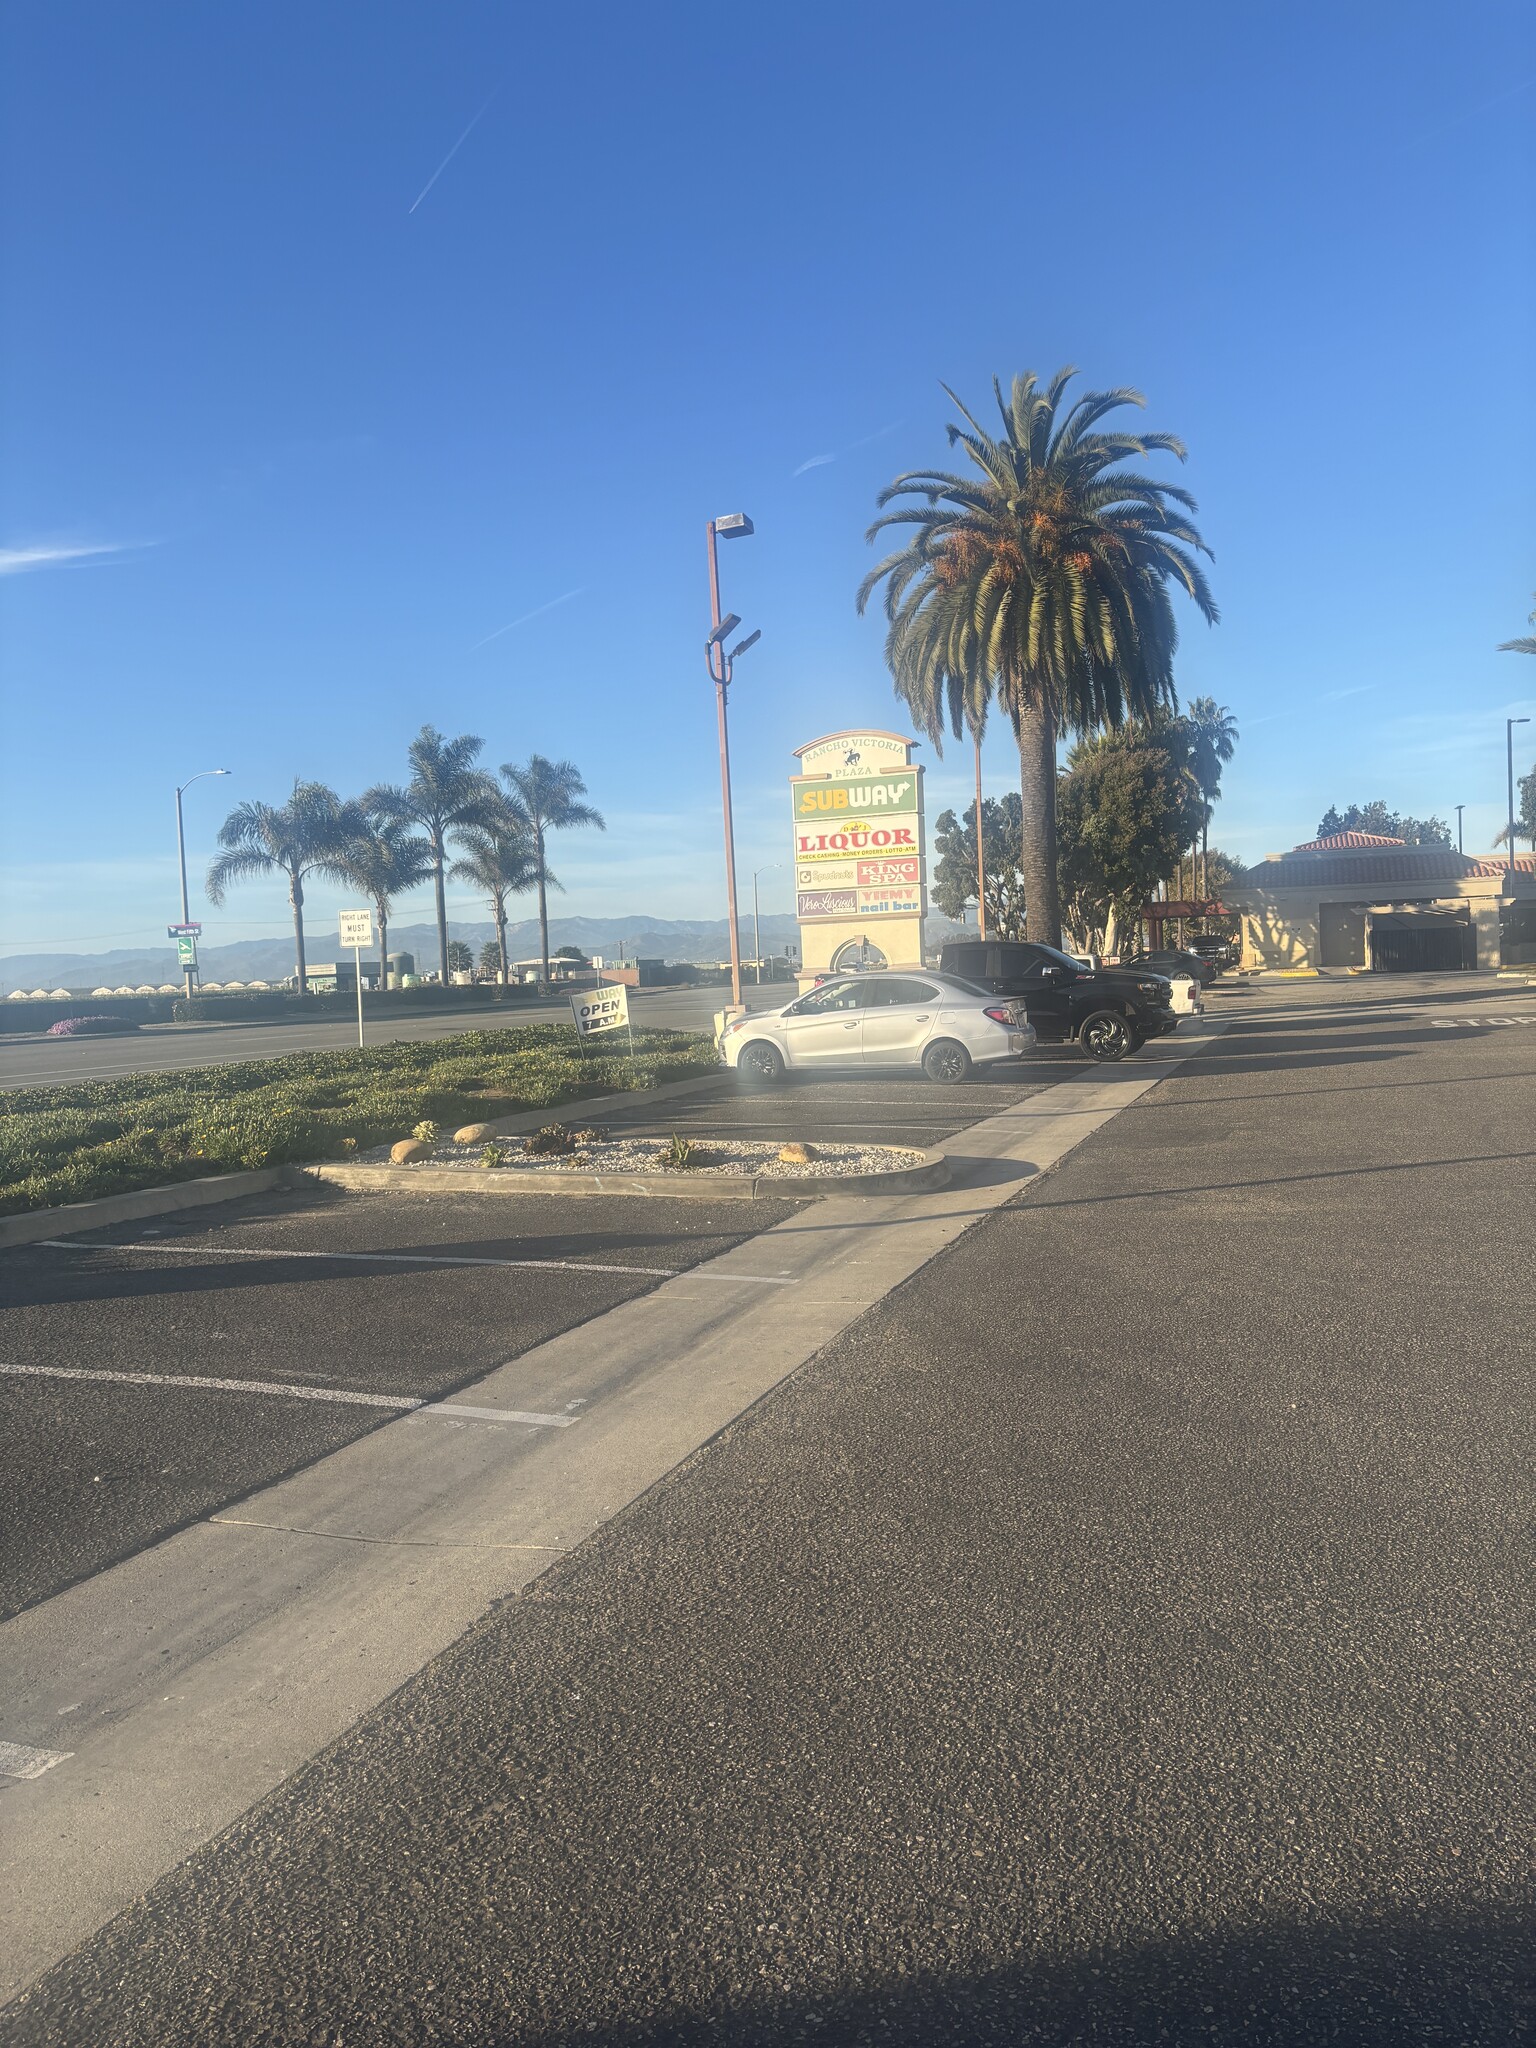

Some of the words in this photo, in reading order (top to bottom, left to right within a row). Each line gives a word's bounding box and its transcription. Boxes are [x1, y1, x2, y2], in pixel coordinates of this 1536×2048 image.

[804, 740, 849, 762] RANCHO
[852, 739, 904, 755] VICTORIA
[835, 766, 872, 778] PLAZA
[799, 782, 911, 814] SUBWAY
[799, 828, 915, 852] LIQUOR
[861, 862, 915, 876] KING
[869, 873, 907, 884] SPA
[862, 889, 915, 901] YIEMY
[860, 902, 888, 913] nail
[893, 900, 918, 911] bar
[580, 999, 620, 1017] OPEN
[1431, 1016, 1536, 1028] STOP
